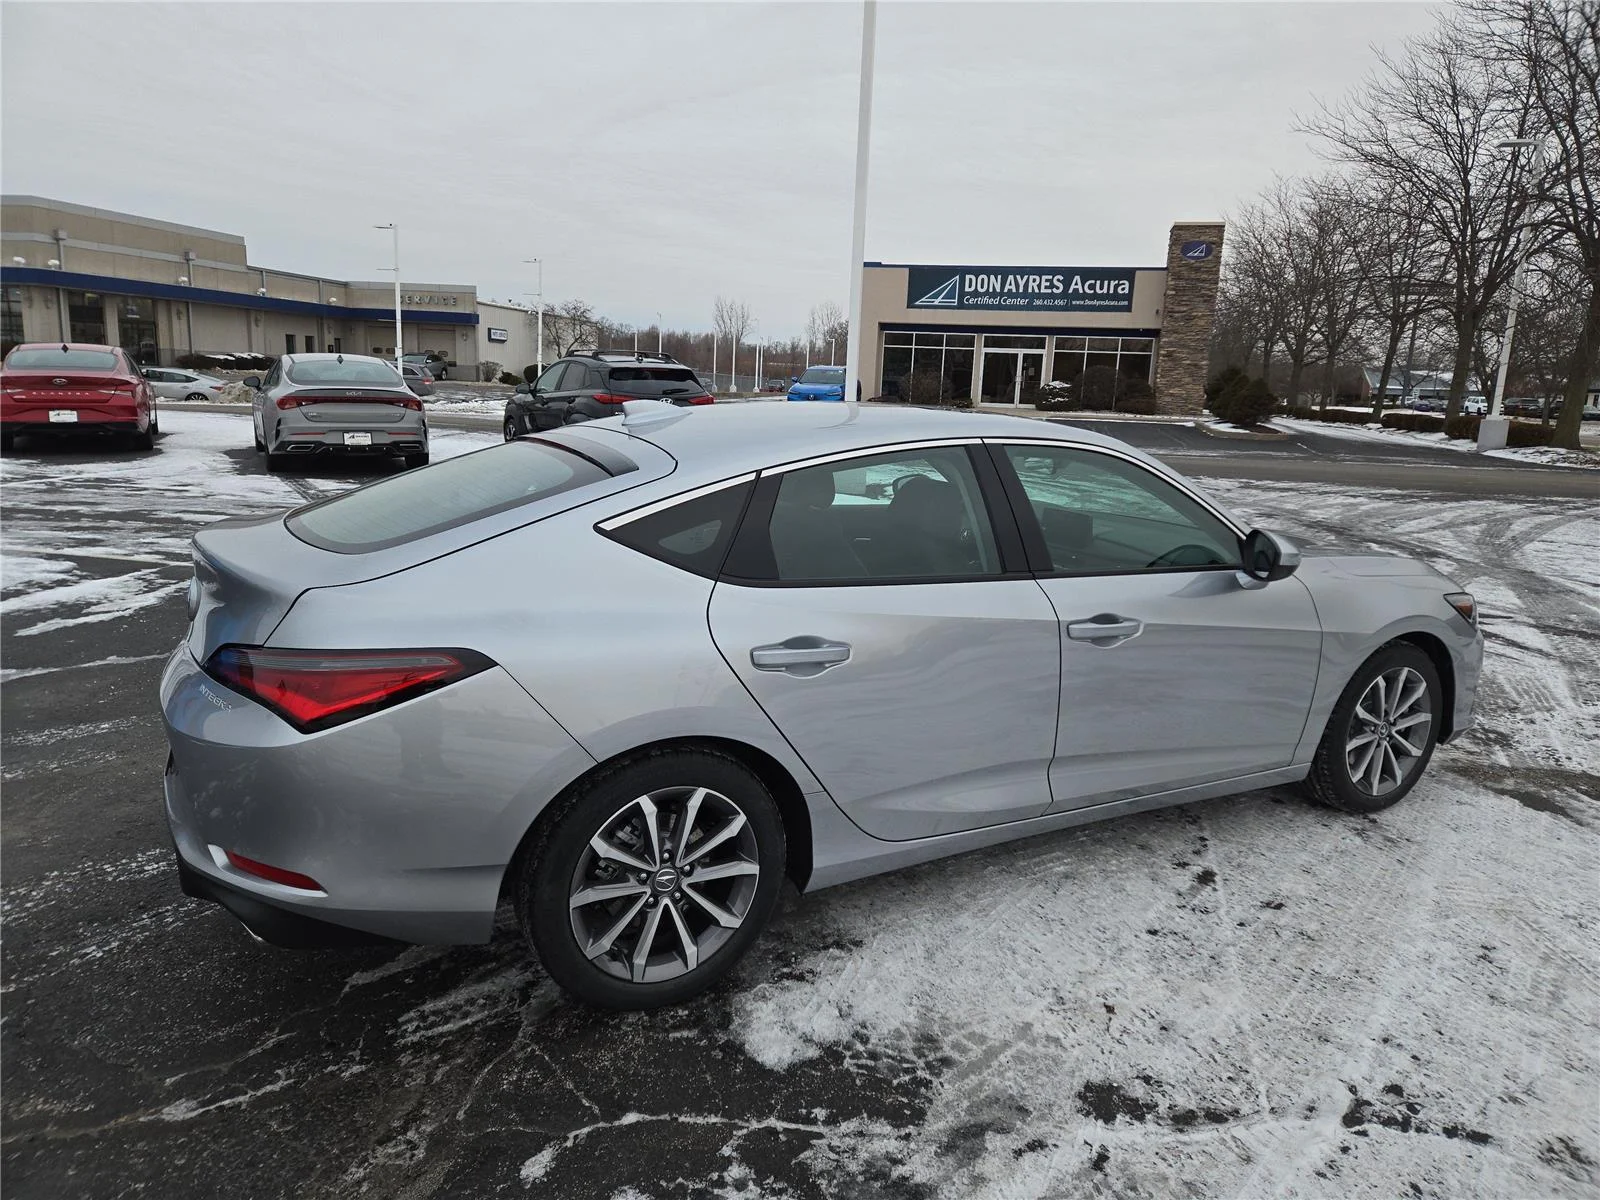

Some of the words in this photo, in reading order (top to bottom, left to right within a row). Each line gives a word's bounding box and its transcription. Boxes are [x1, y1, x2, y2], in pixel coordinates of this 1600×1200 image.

[964, 274, 1002, 293] DON
[1003, 275, 1064, 294] AYRES
[1068, 275, 1130, 294] Acura
[963, 295, 1000, 305] Certified
[1000, 296, 1030, 305] Center
